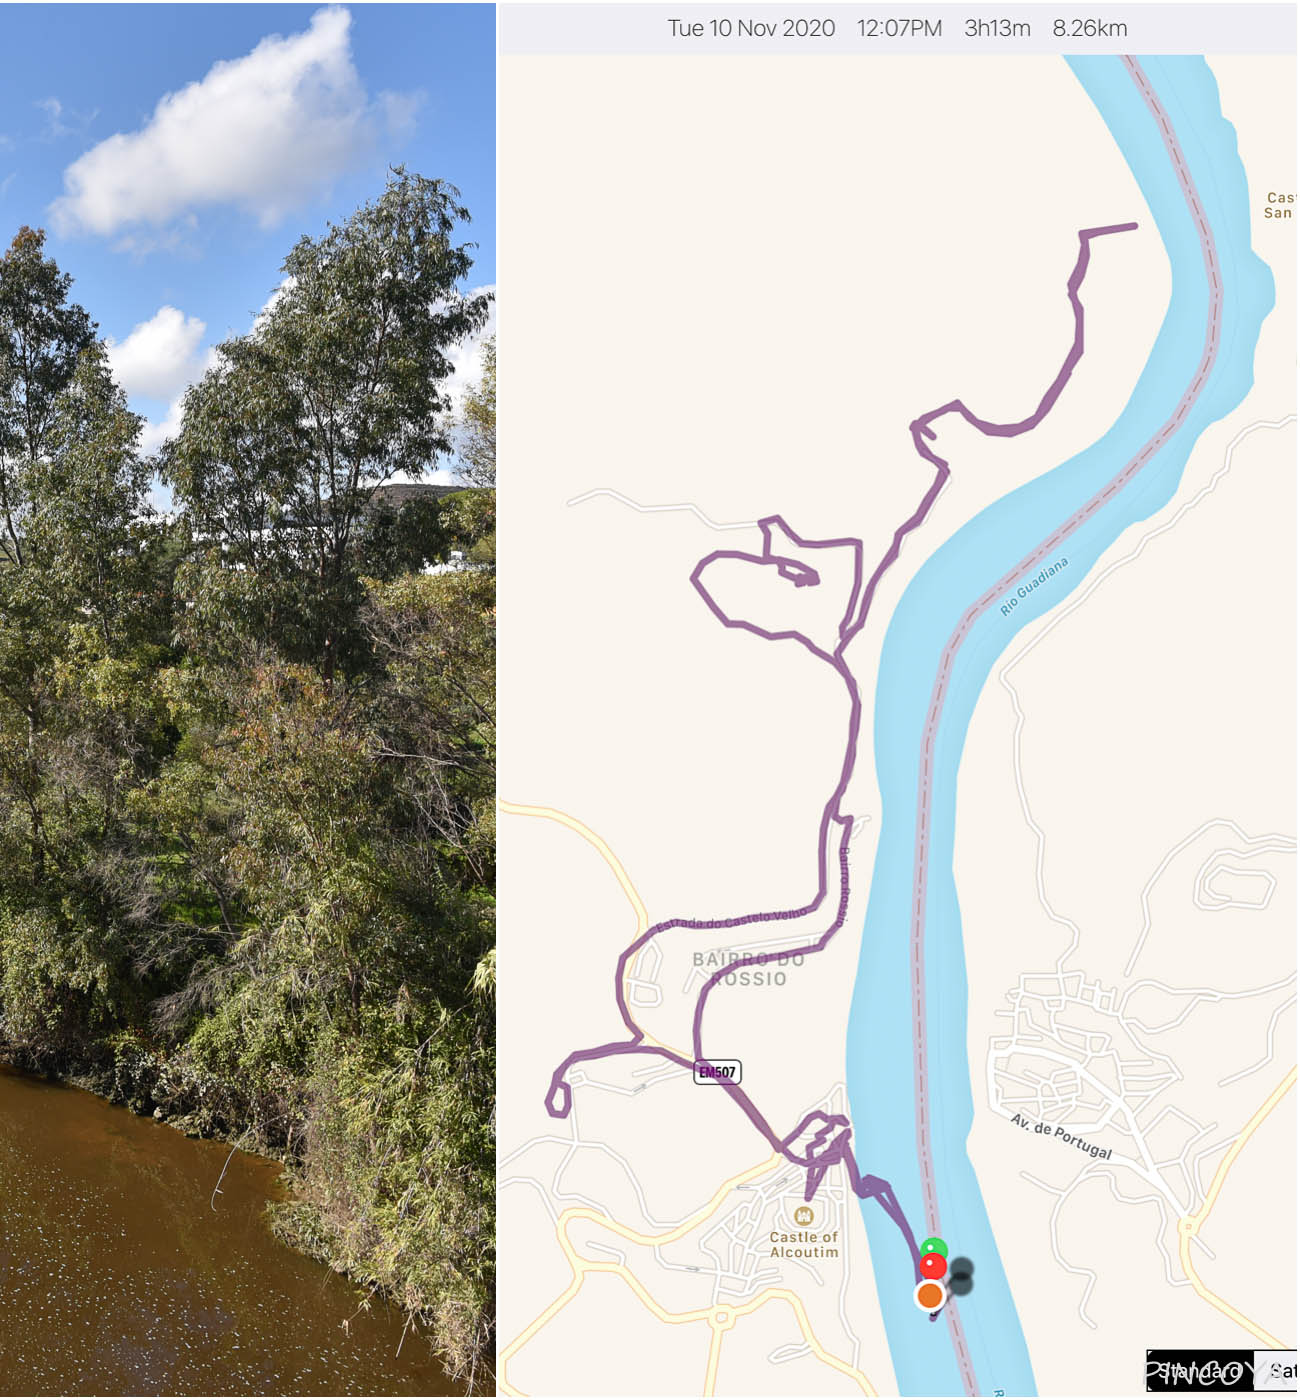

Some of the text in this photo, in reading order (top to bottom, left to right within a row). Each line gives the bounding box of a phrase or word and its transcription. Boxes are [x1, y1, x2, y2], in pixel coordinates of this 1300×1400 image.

[667, 18, 1128, 37] Tue 10 Nov 2020 12:07PM 3h13m 8.26km
[1264, 207, 1292, 219] San
[1000, 558, 1068, 616] Rio Guadiana
[835, 847, 852, 928] Bairro Rossio
[655, 908, 808, 933] Estrada do Castelo Velho
[693, 952, 806, 967] BAIRRO DO
[711, 971, 787, 986] ROSSIO
[699, 1066, 736, 1079] EM507
[1010, 1113, 1112, 1160] Av. de Portugal
[769, 1231, 839, 1243] Castle of
[769, 1247, 840, 1258] Alcoutim
